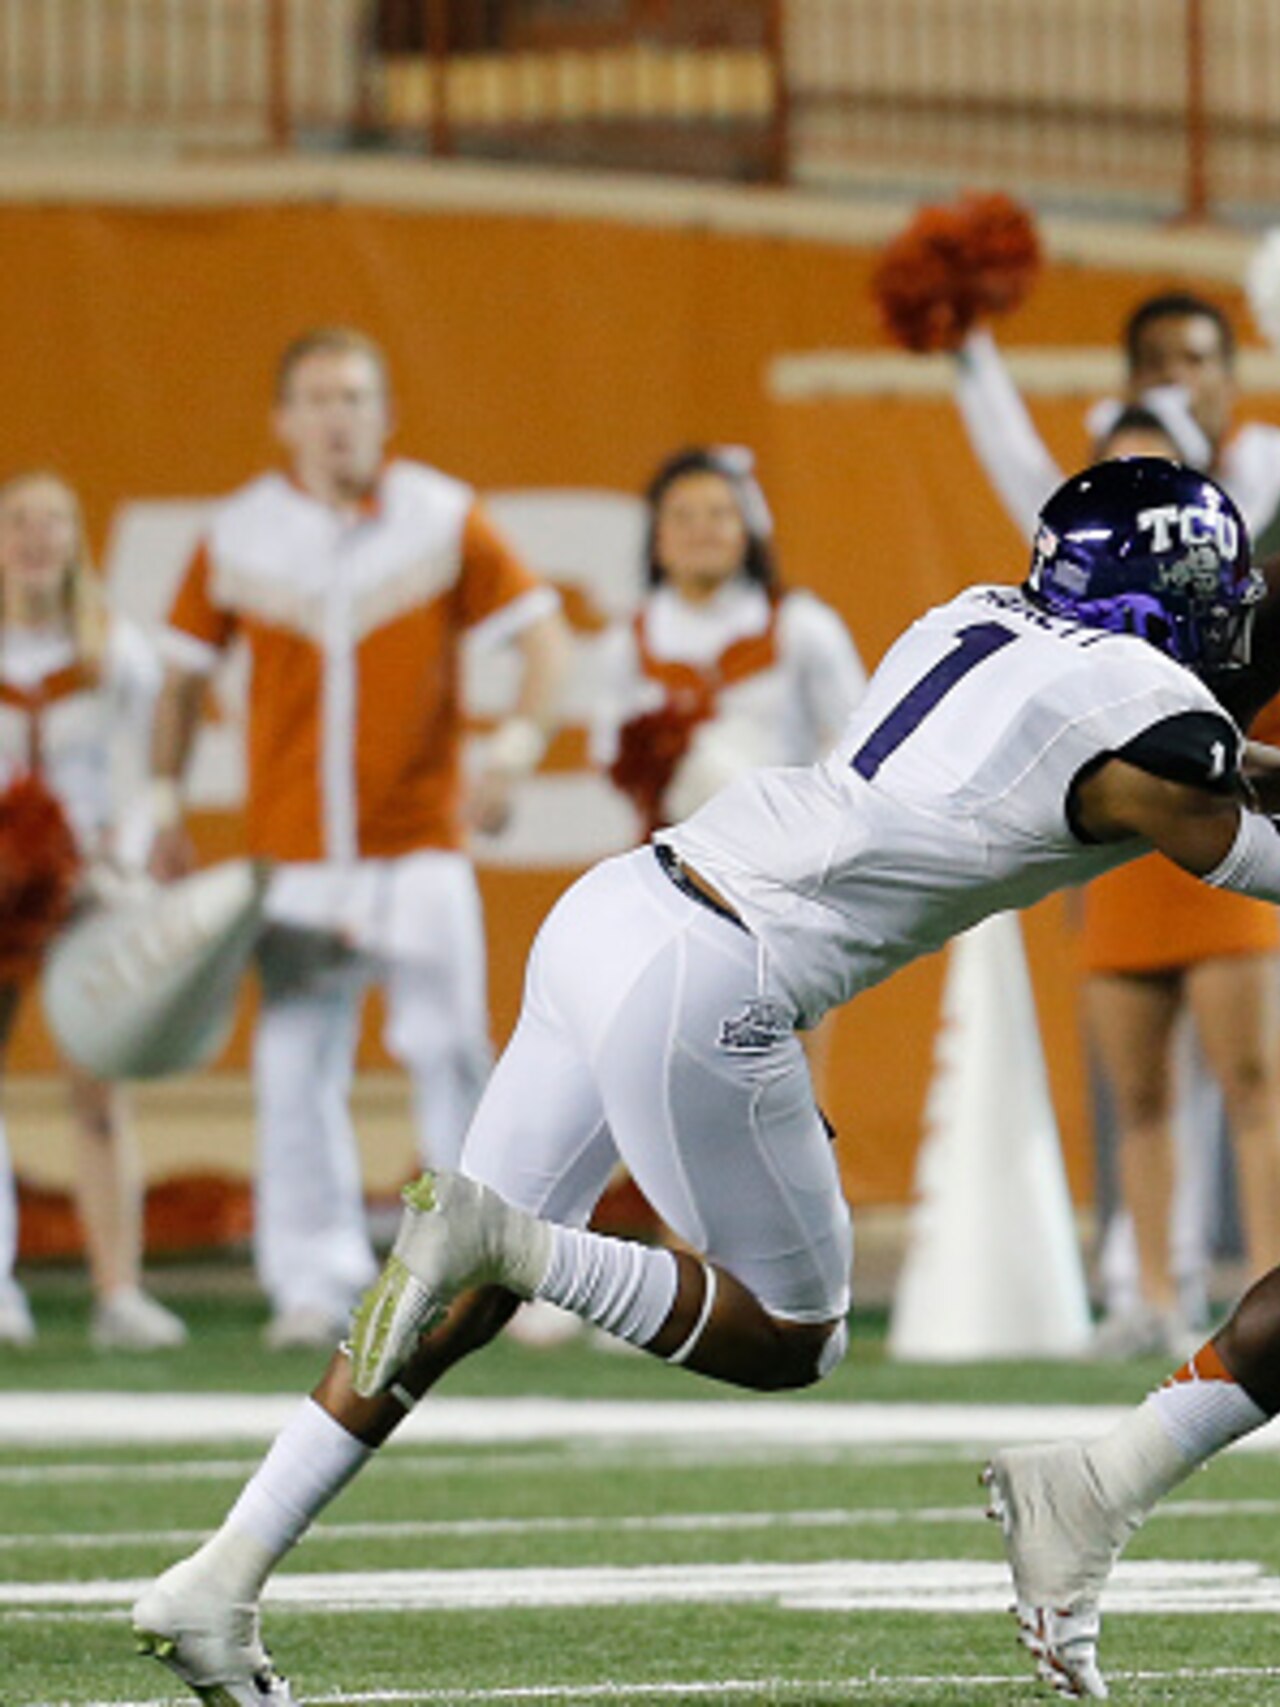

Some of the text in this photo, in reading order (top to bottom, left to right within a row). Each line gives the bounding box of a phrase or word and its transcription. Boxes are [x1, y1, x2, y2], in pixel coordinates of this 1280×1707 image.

[1137, 502, 1238, 561] TCU
[850, 620, 1020, 782] 1
[1208, 741, 1225, 779] 1
